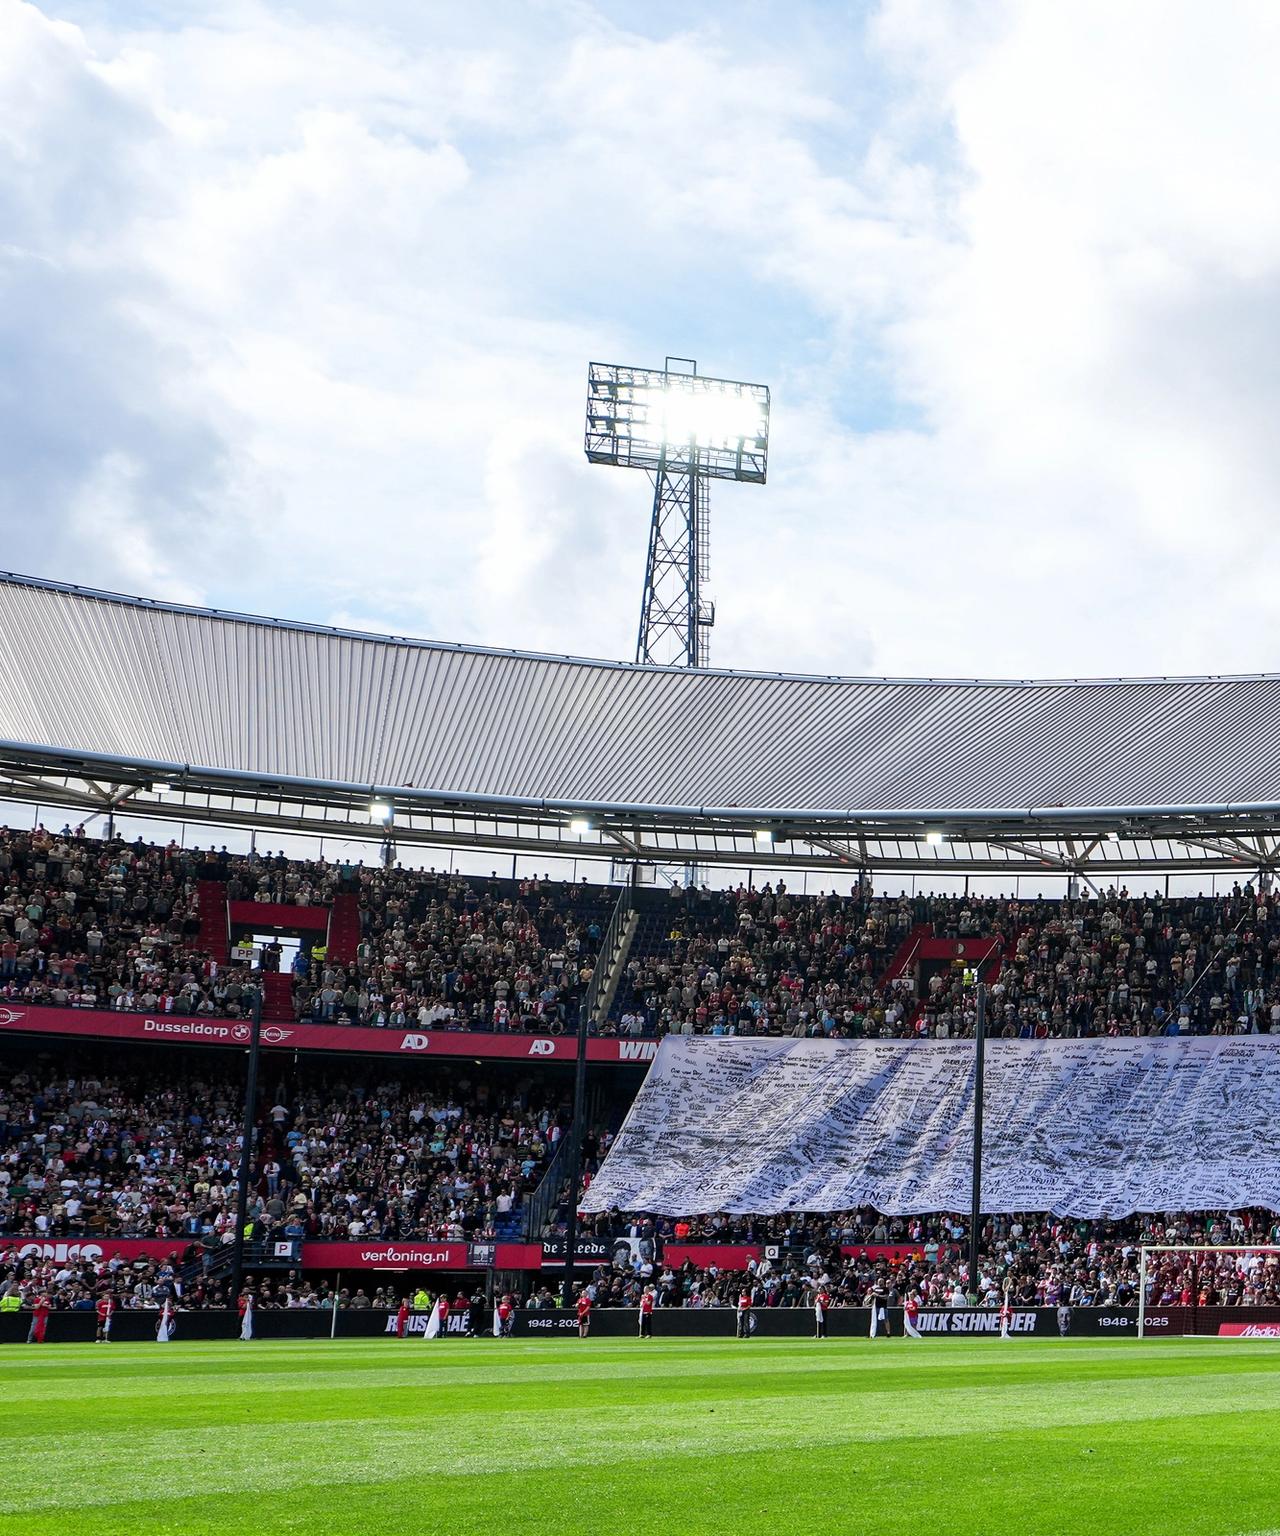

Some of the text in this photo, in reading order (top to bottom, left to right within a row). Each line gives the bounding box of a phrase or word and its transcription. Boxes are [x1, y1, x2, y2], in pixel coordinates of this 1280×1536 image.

[144, 1020, 228, 1037] Dusseldorp
[400, 1034, 428, 1050] AD
[528, 1040, 555, 1055] AD
[279, 1245, 287, 1253] P
[543, 1242, 558, 1253] de
[768, 1248, 776, 1256] Q
[361, 1248, 449, 1264] verloning.nl
[385, 1316, 428, 1331] RUS
[528, 1319, 580, 1328] 1942-202
[917, 1313, 1037, 1331] DICK SCHNEDER
[1240, 1325, 1276, 1337] Media
